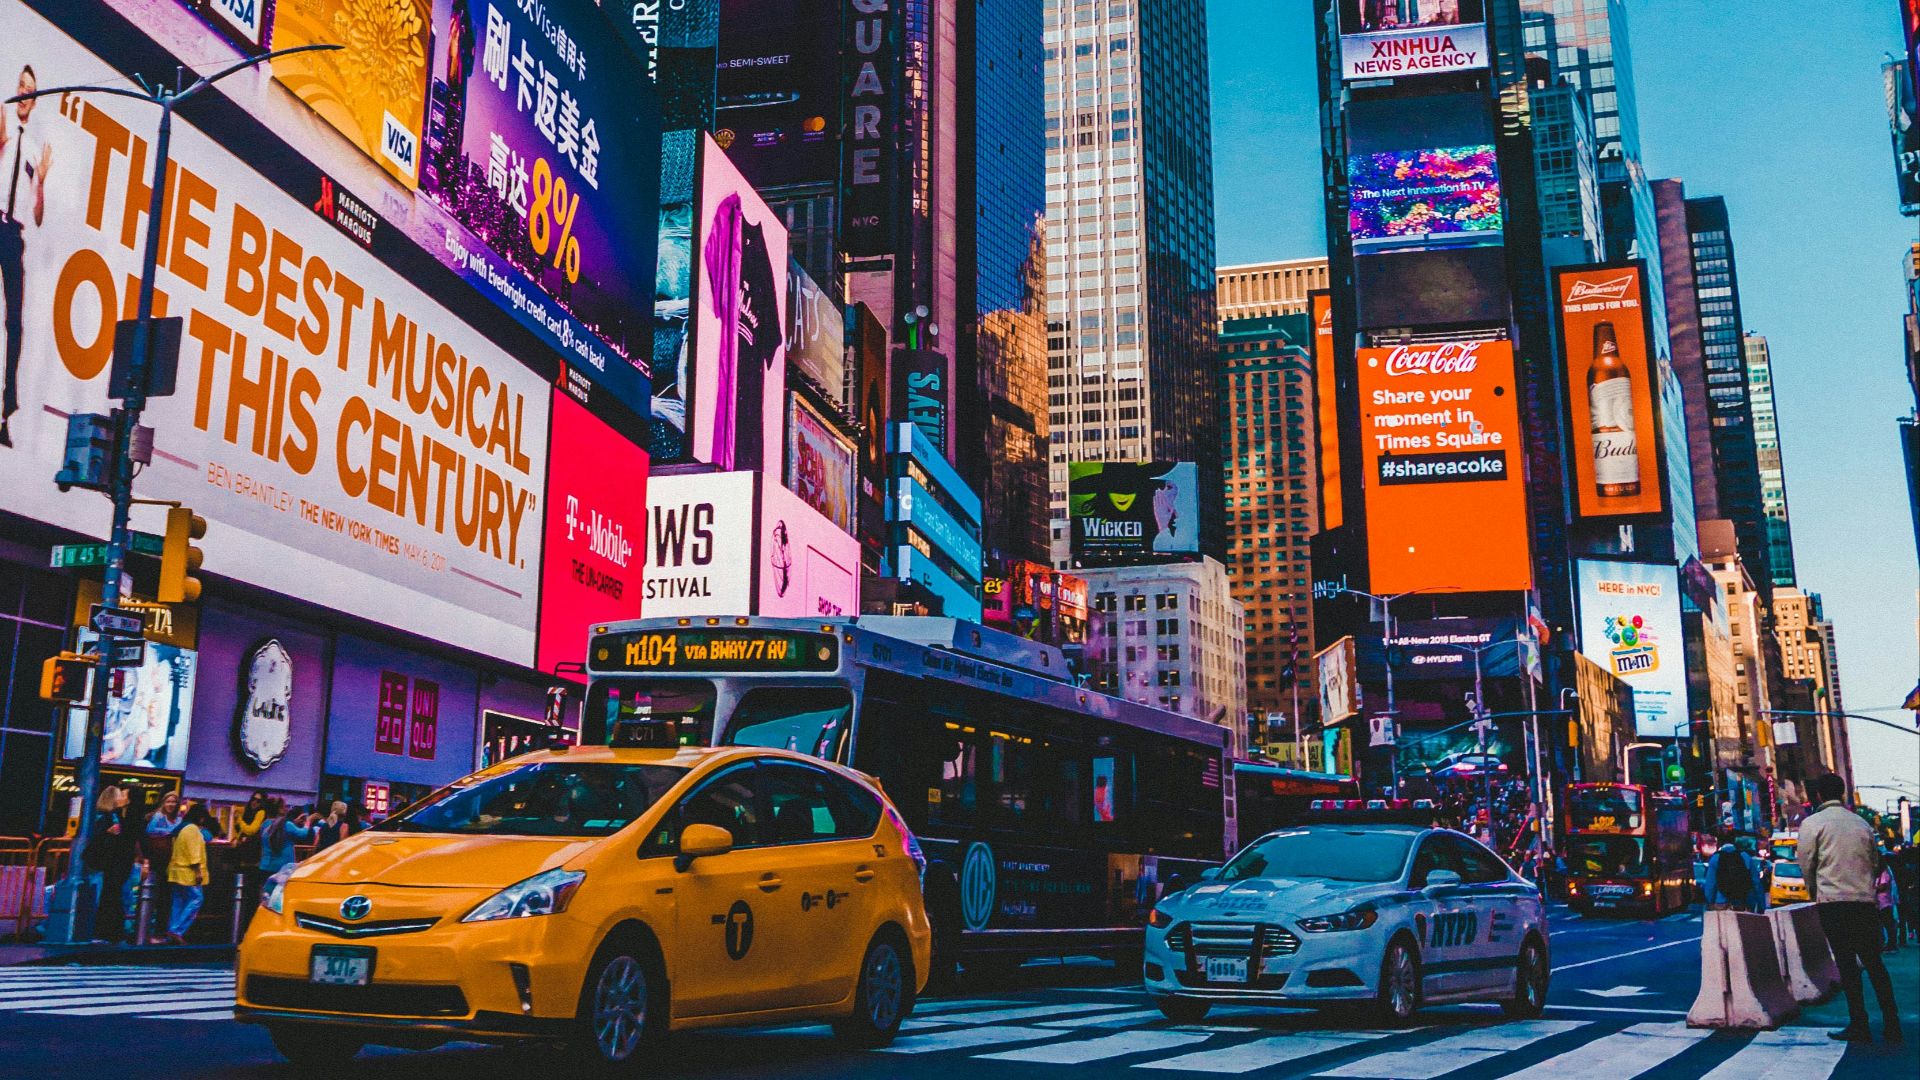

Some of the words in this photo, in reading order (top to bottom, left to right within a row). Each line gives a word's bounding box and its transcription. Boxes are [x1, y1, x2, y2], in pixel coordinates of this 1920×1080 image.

[1371, 36, 1457, 58] XINHUA
[730, 54, 790, 68] SEMI-SWEET
[1354, 58, 1402, 74] NEWS
[1407, 52, 1476, 70] AGENCY
[483, 3, 600, 190] 刷卡返美金
[386, 121, 412, 167] VISA
[1362, 190, 1381, 199] The
[1382, 187, 1405, 198] Next
[1407, 183, 1459, 195] Innovation
[1461, 182, 1470, 191] in
[1471, 181, 1485, 191] TV
[338, 192, 377, 230] MARRIOTT
[487, 131, 529, 218] 高达
[529, 157, 580, 284] 8%
[337, 210, 372, 244] MARQUIS
[852, 215, 880, 227] NYC
[445, 229, 469, 269] Enjoy
[469, 253, 488, 279] with
[488, 263, 526, 312] Everbright
[526, 298, 547, 326] credit
[575, 337, 590, 358] cash
[1571, 283, 1627, 297] Budweiser
[1565, 304, 1581, 313] THIS
[1606, 300, 1621, 309] FOR
[225, 203, 365, 371] BEST
[367, 297, 531, 475] MUSICAL
[569, 367, 591, 392] MARRIOTT
[189, 308, 321, 476] THIS
[568, 383, 588, 403] MARQUIS
[1372, 389, 1425, 405] Share
[1430, 388, 1472, 404] your
[1374, 409, 1452, 427] moment
[1457, 408, 1474, 422] in
[1375, 434, 1431, 450] Times
[1436, 431, 1502, 449] Square
[1381, 456, 1503, 478] #shareacoke
[207, 462, 231, 491] BEN
[235, 474, 294, 513] BRANTLEY
[300, 499, 319, 525] THE
[322, 505, 345, 534] NEW
[347, 517, 372, 546] YORK
[374, 529, 400, 556] TIMES
[403, 543, 421, 562] MAY
[644, 502, 714, 568] WS
[1082, 517, 1143, 537] WICKED
[79, 548, 94, 563] 45
[571, 558, 585, 583] THE
[1598, 582, 1625, 594] HERE
[1626, 583, 1635, 594] in
[1636, 583, 1660, 596] NYC!
[1430, 635, 1449, 645] 2018
[1450, 634, 1478, 644] Elantra
[1479, 632, 1492, 643] GT
[625, 634, 677, 666] M104
[685, 645, 707, 660] VIA
[710, 640, 764, 661] BWAY/7
[767, 640, 788, 660] AV
[1426, 654, 1463, 663] HYUNDAI
[415, 689, 435, 719] UNI
[413, 721, 433, 752] QLO
[1206, 901, 1269, 910] POLICE
[1430, 911, 1478, 948] NYPD
